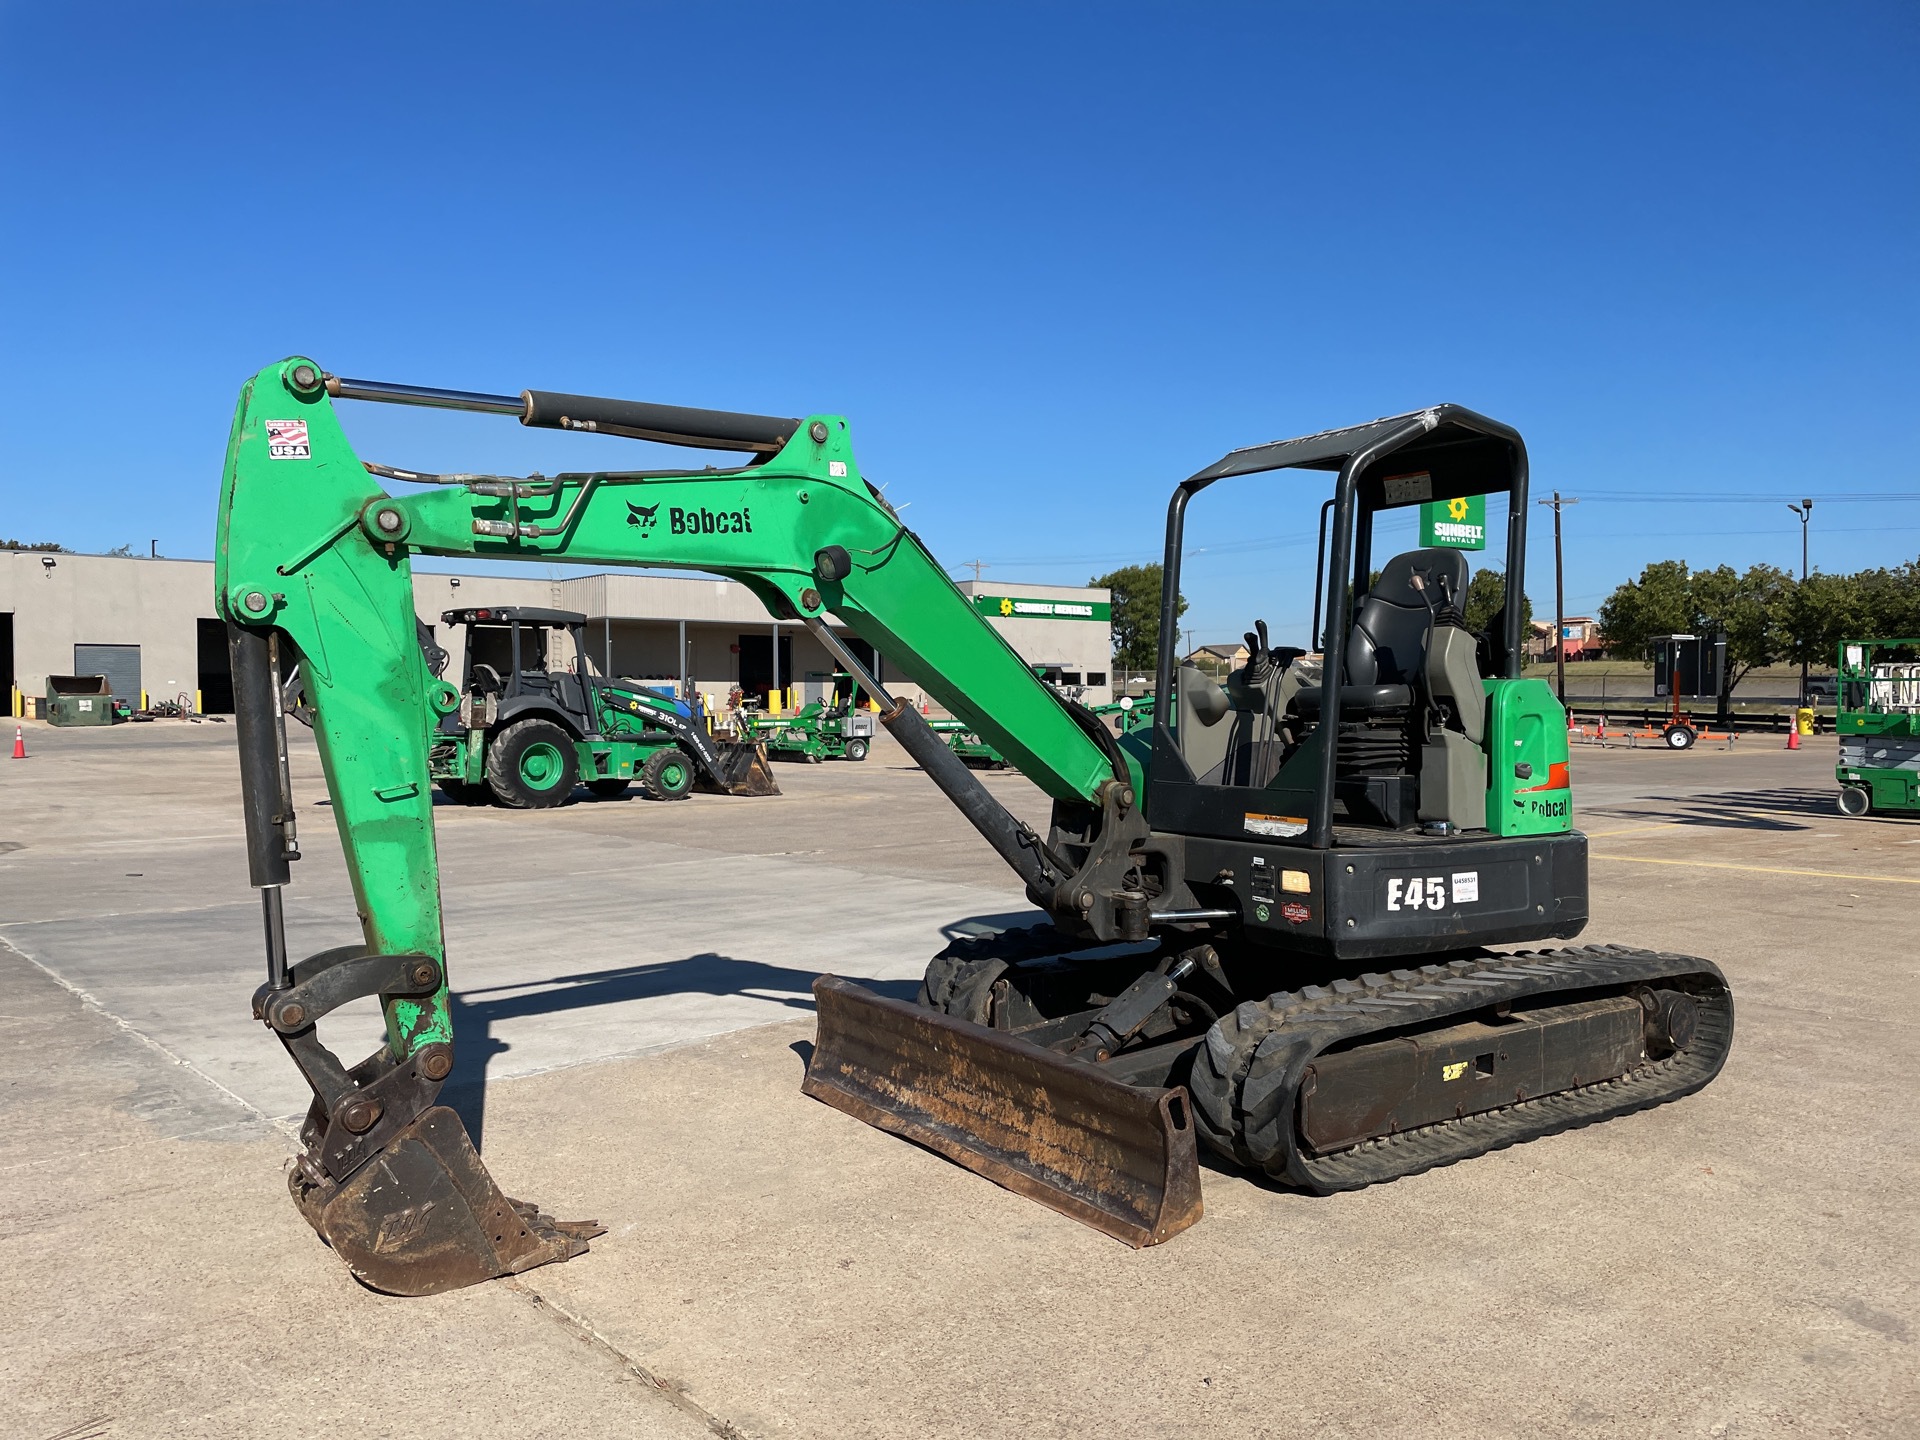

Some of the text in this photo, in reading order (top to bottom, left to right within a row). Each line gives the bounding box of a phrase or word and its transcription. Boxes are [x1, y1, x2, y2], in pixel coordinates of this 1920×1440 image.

[271, 445, 308, 457] USA
[669, 506, 753, 535] Bobcat
[1434, 522, 1483, 539] SUNBELT
[1441, 536, 1476, 545] RENTALS
[1014, 602, 1093, 616] SUNBELT RENTALS
[658, 711, 678, 728] 310L
[1387, 876, 1446, 911] E45
